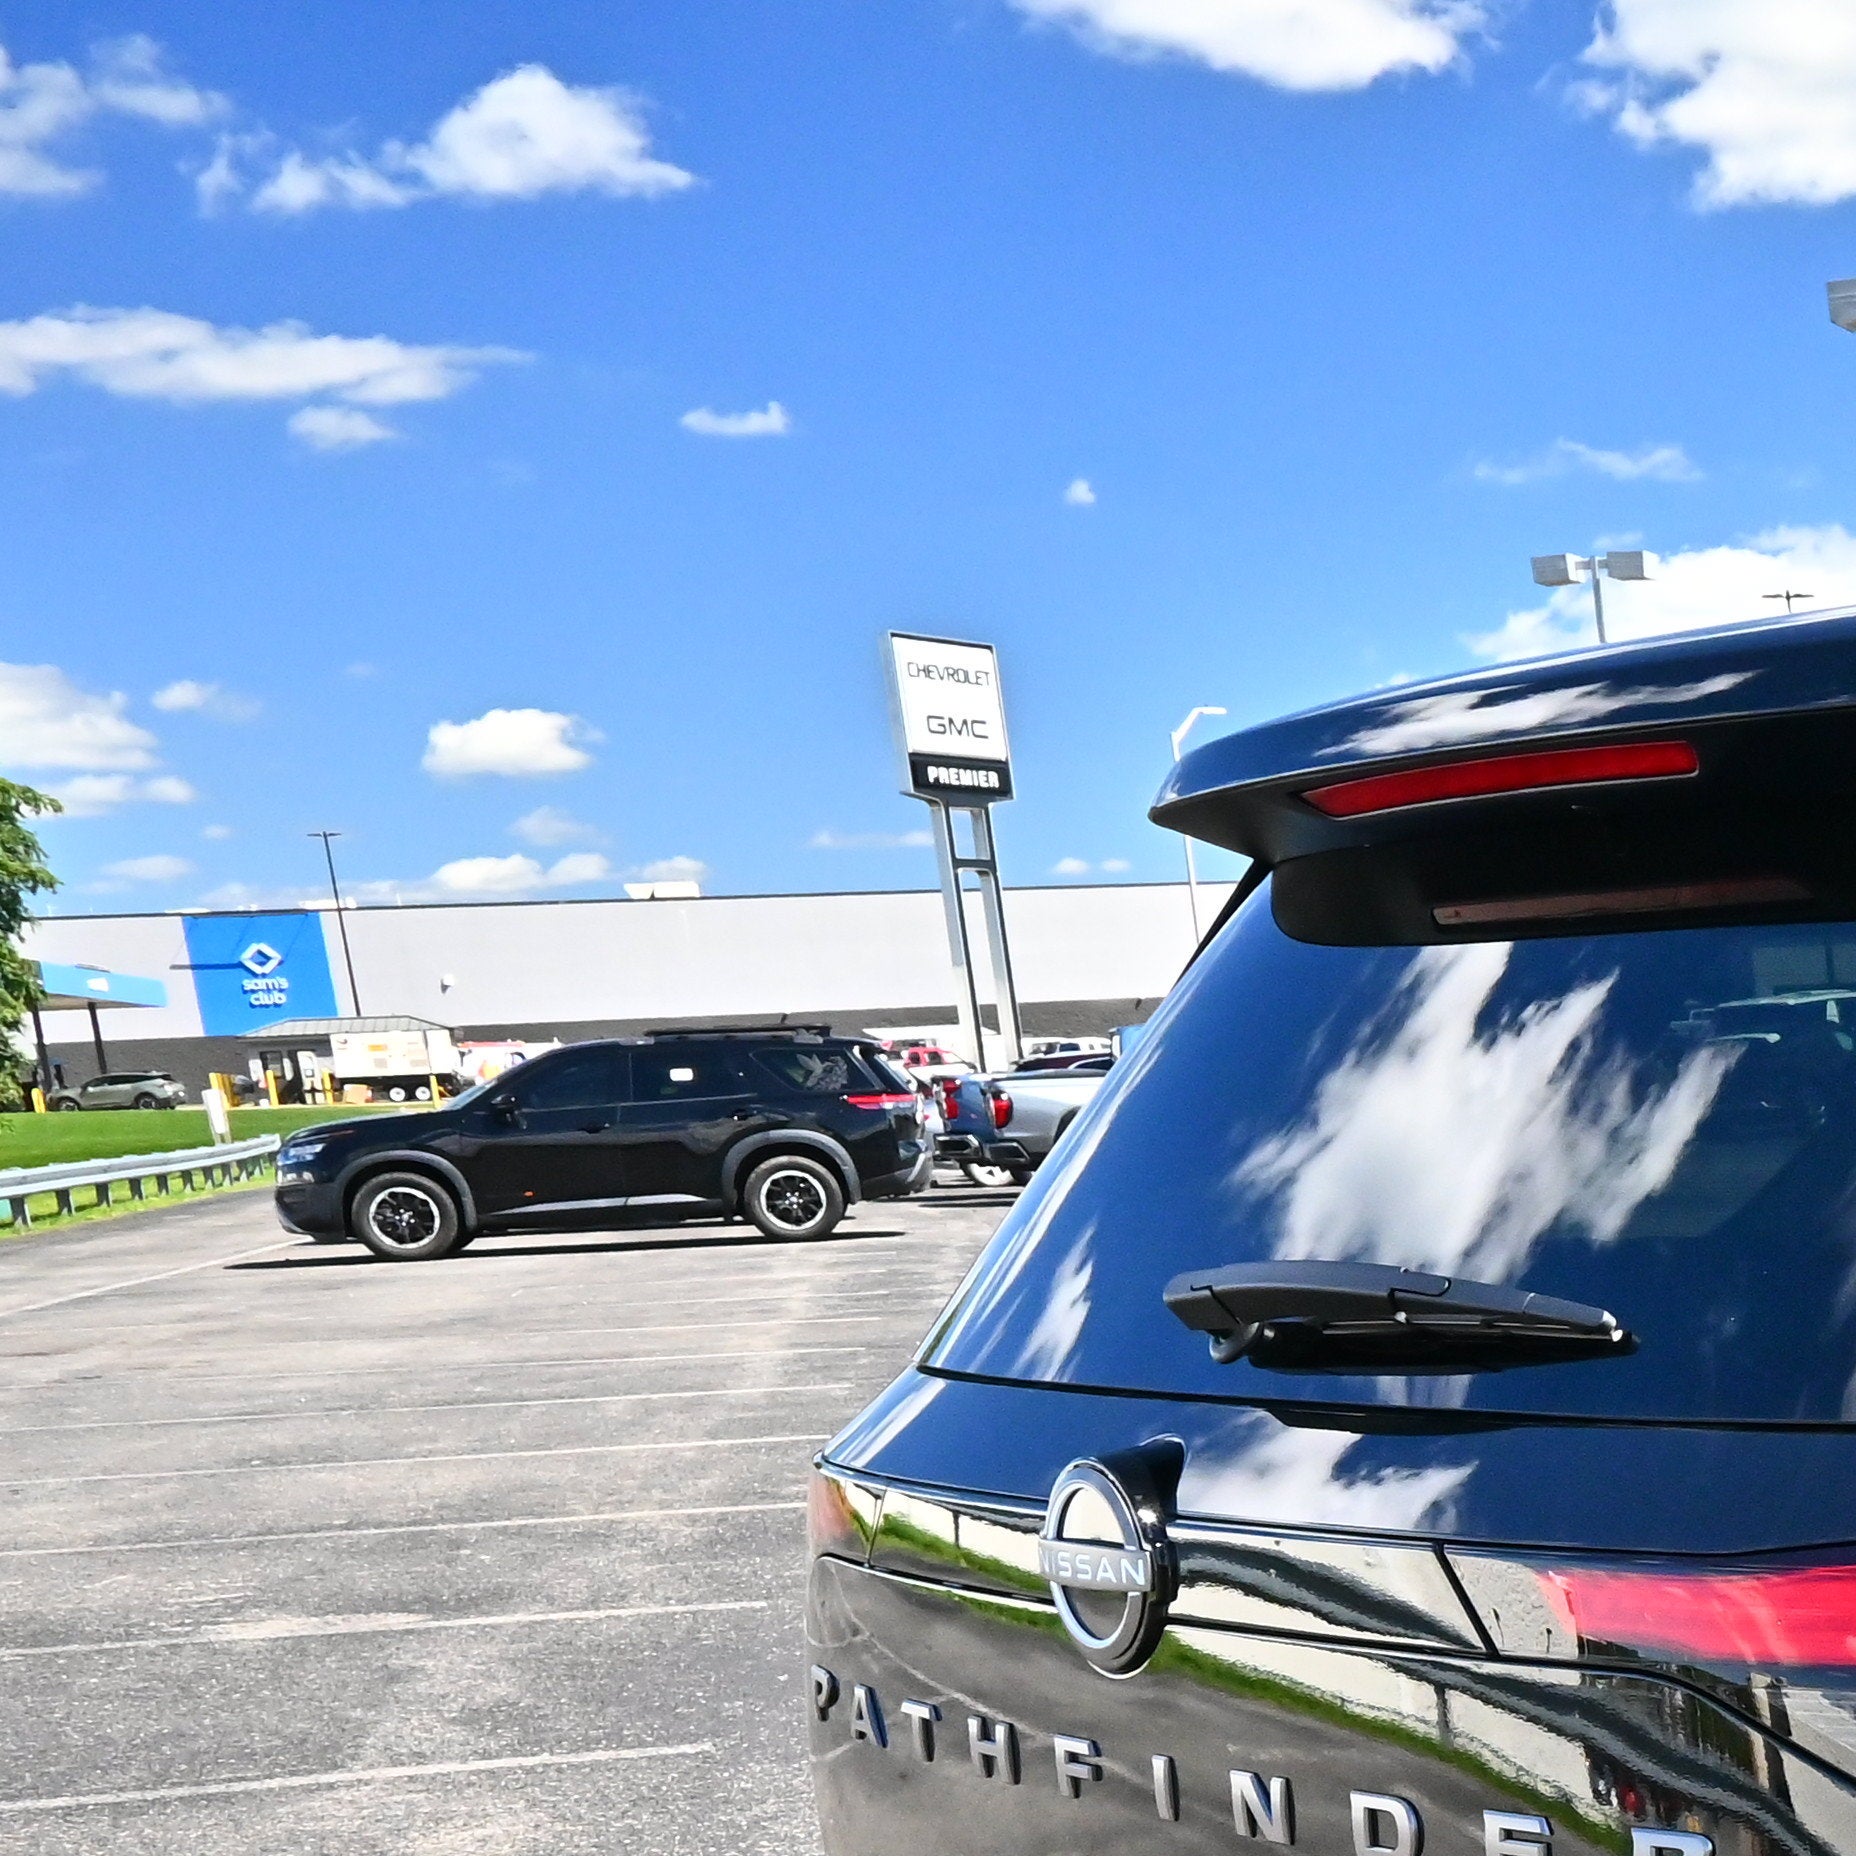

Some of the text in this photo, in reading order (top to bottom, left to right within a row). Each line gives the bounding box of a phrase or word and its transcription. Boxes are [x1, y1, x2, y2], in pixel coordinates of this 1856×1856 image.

[907, 661, 990, 686] CHEVROLET
[926, 715, 989, 739] GMC
[926, 765, 1000, 788] PREMIER
[249, 991, 287, 1005] club
[1039, 1547, 1146, 1586] NISSAN
